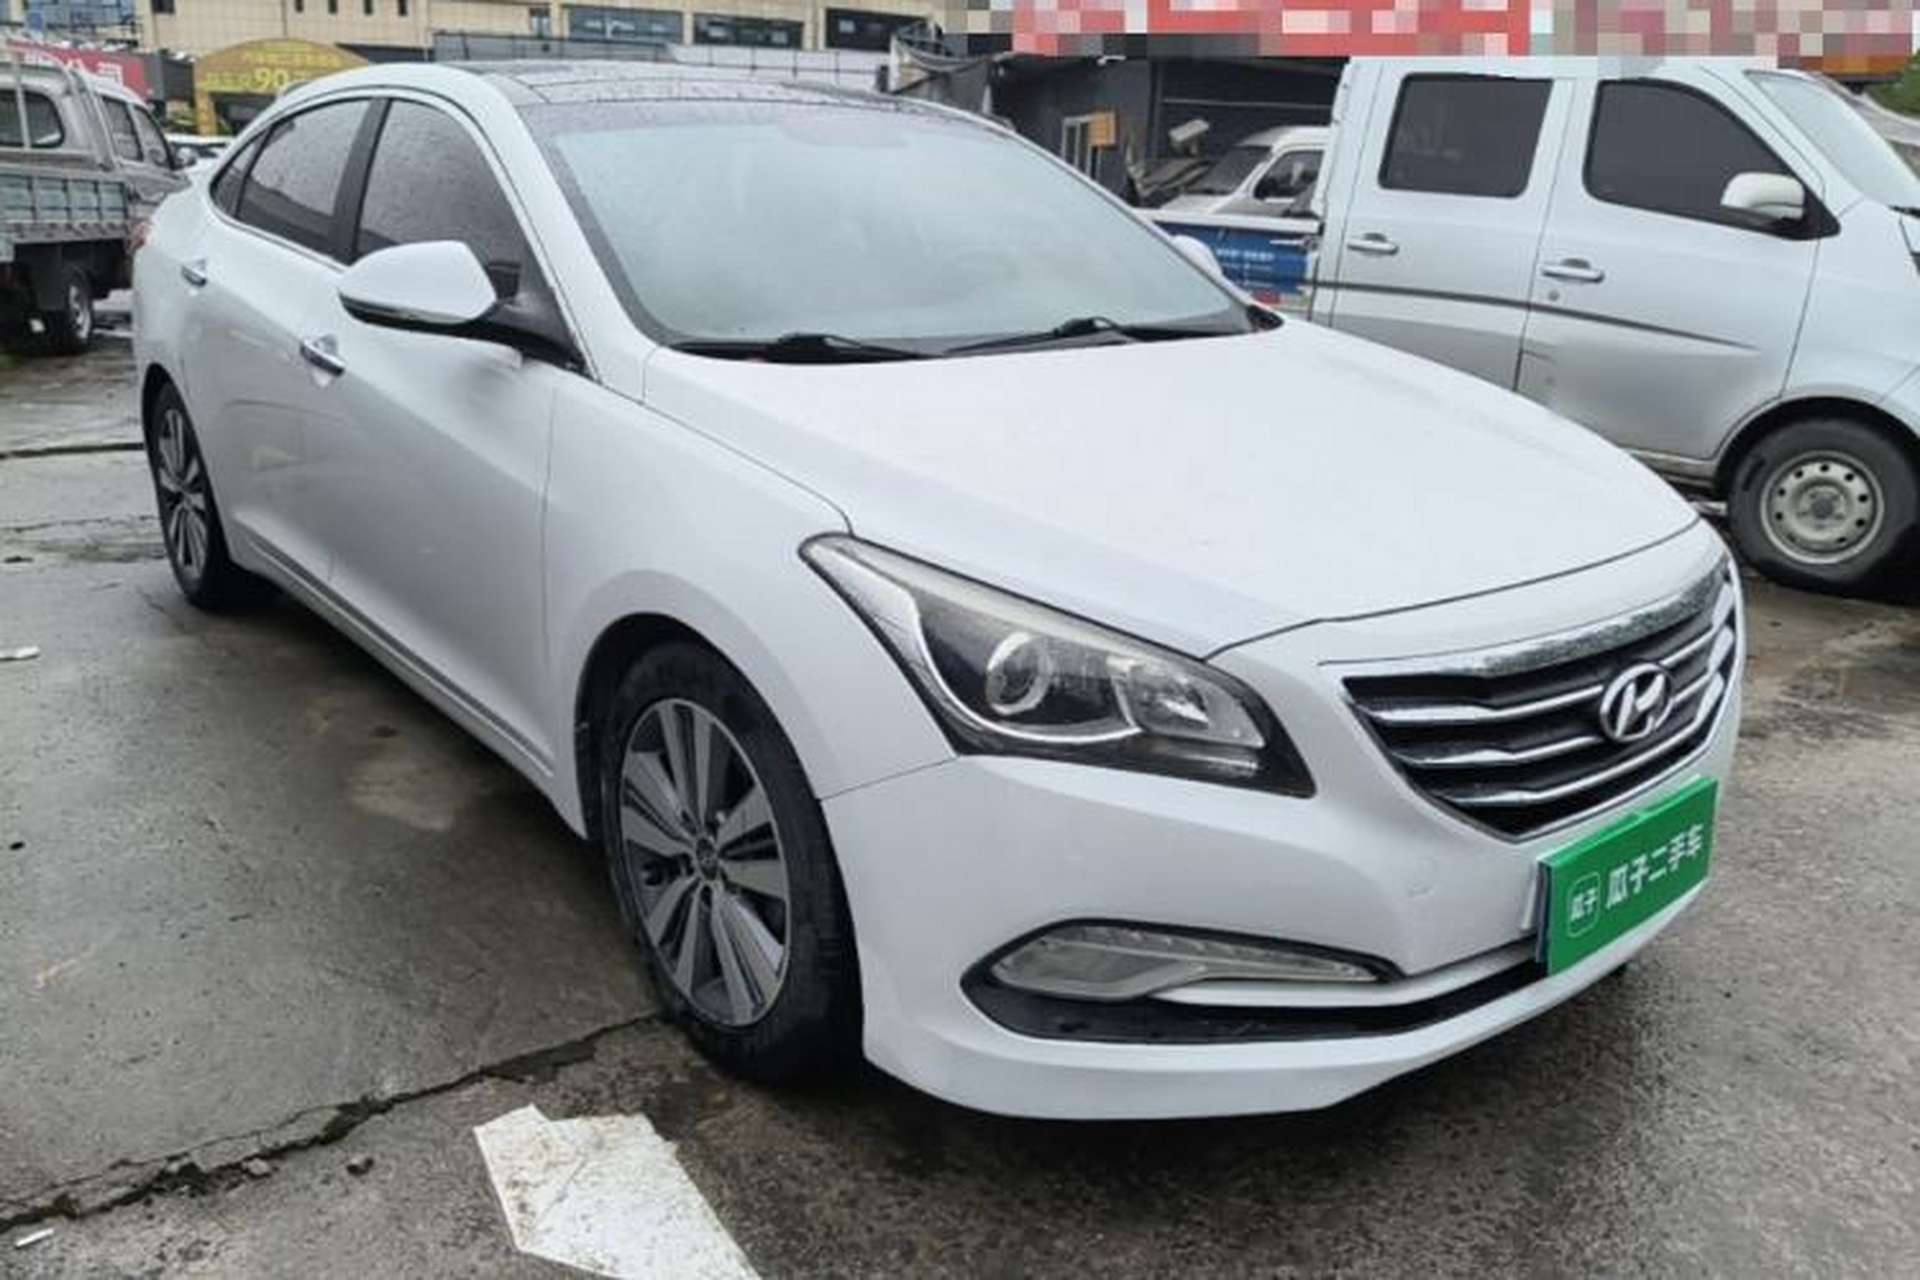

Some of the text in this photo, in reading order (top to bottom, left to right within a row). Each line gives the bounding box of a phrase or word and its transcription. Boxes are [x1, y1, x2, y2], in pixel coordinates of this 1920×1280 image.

[1605, 823, 1704, 910] 瓜子二手车
